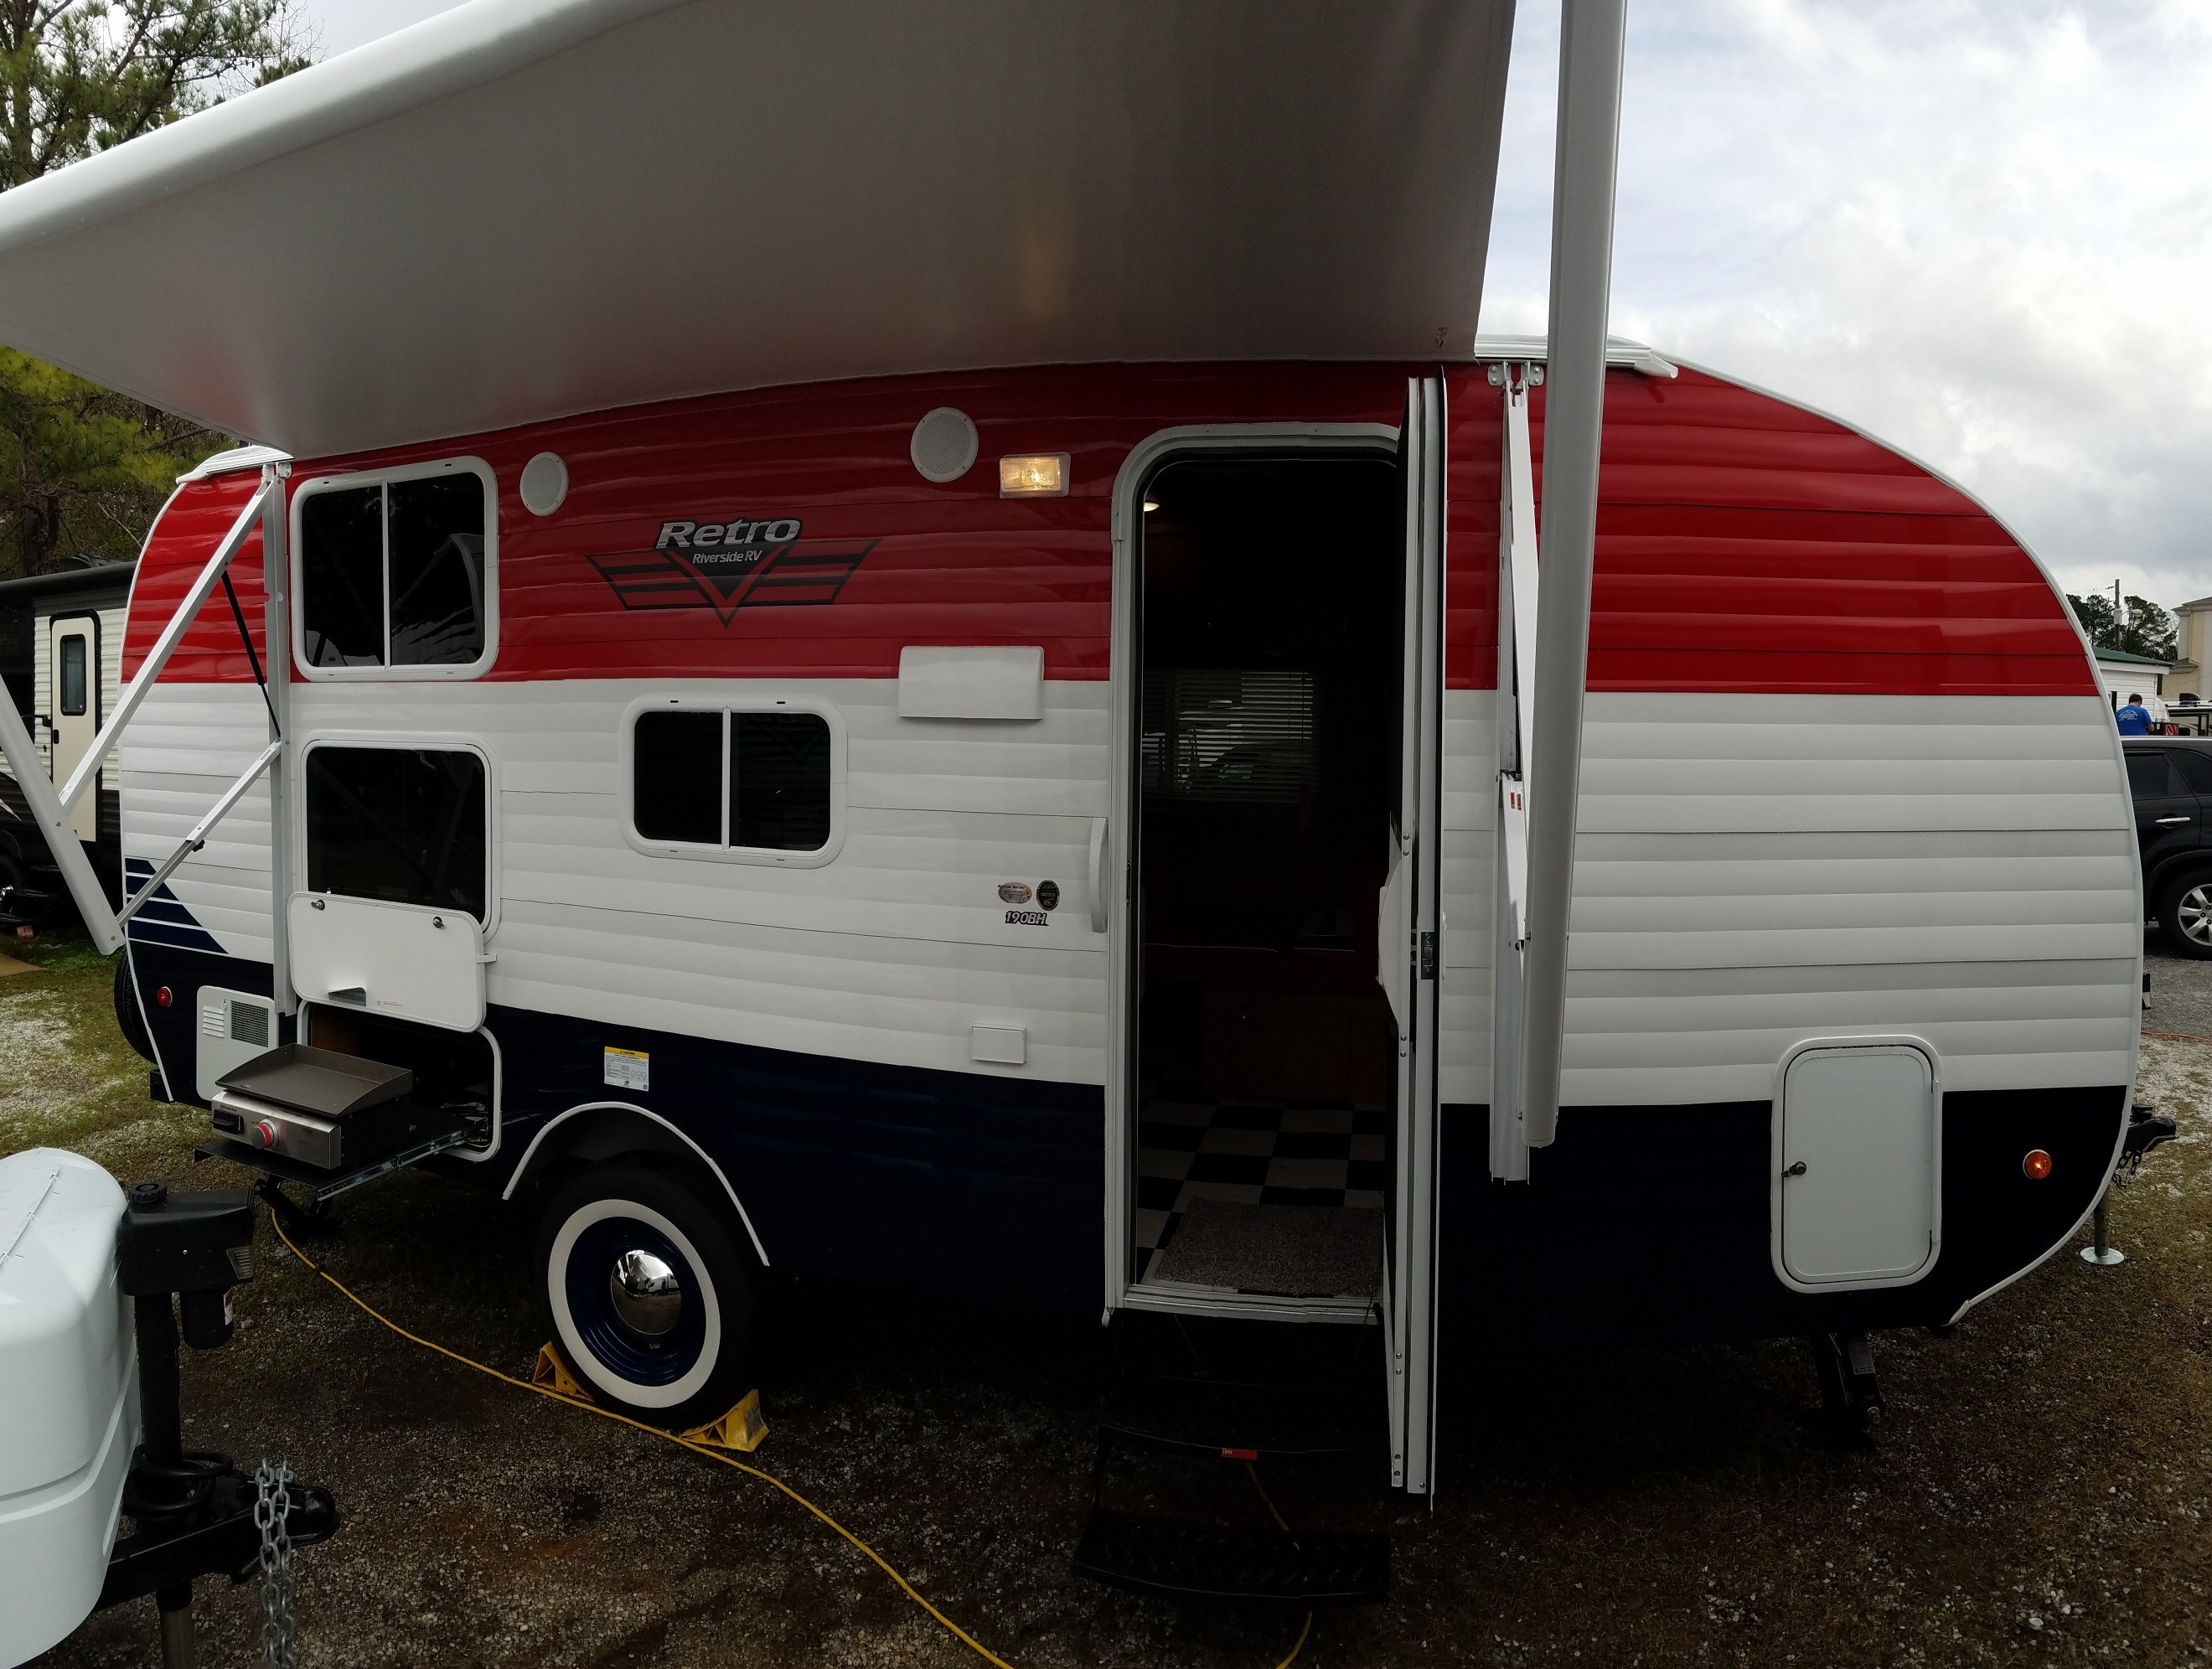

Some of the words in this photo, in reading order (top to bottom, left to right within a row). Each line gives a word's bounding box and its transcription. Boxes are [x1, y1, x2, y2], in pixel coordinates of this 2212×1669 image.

[654, 518, 802, 550] Retro
[691, 550, 744, 565] Riverside
[745, 550, 763, 562] RV
[1005, 911, 1047, 925] 190BH
